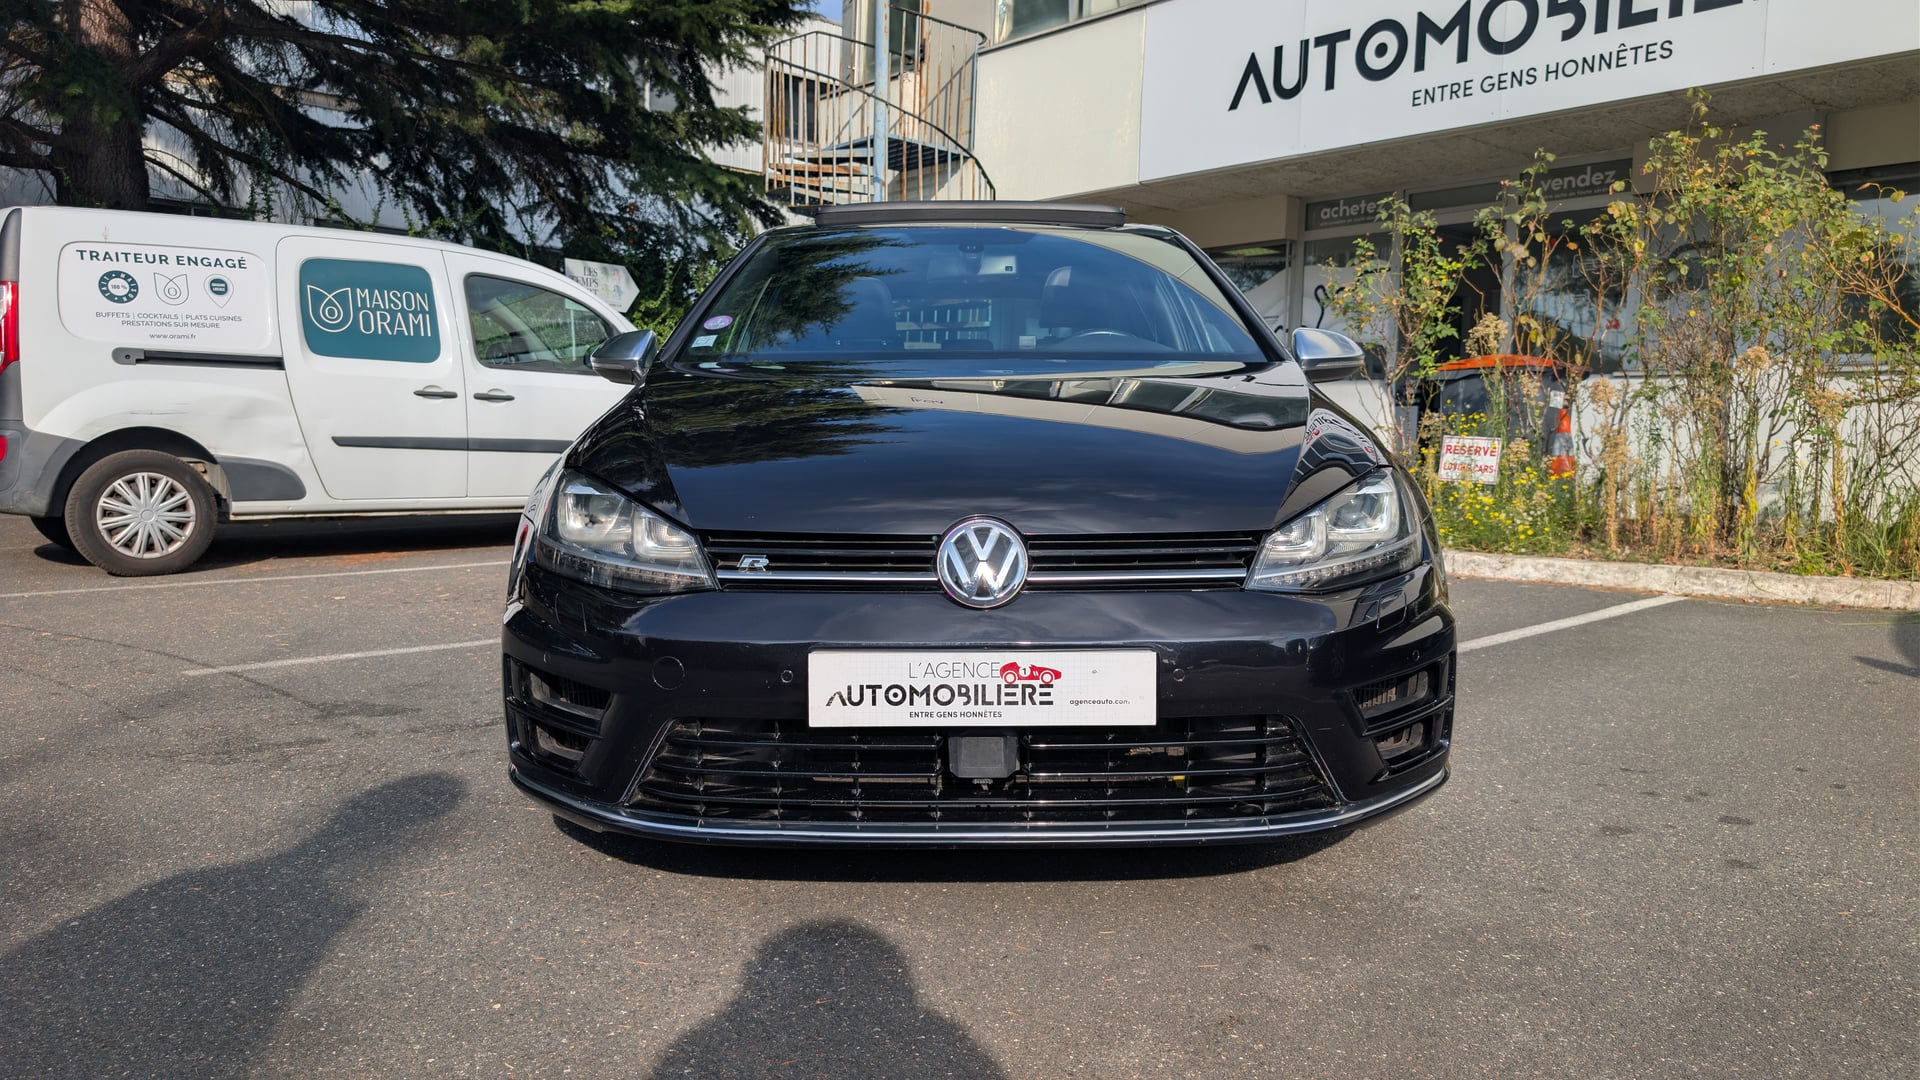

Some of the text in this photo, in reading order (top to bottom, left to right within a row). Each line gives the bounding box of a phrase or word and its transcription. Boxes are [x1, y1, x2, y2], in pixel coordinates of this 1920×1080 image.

[1228, 0, 1744, 111] AUTOMOBIL
[1412, 40, 1673, 107] ENTRE GENS HONNÊTES
[1541, 166, 1616, 191] vendez
[76, 249, 248, 270] TRAITEUR ENGAGÉ
[356, 287, 429, 312] MAISON
[95, 311, 131, 319] BUFFETS
[137, 312, 179, 320] COCKTAILS
[185, 313, 209, 321] PLATS
[121, 320, 173, 328] PRESTATIONS
[359, 309, 432, 337] ORAMI
[908, 662, 1001, 679] L'AGENCE
[909, 711, 935, 719] ENTRE
[936, 711, 958, 719] GENS
